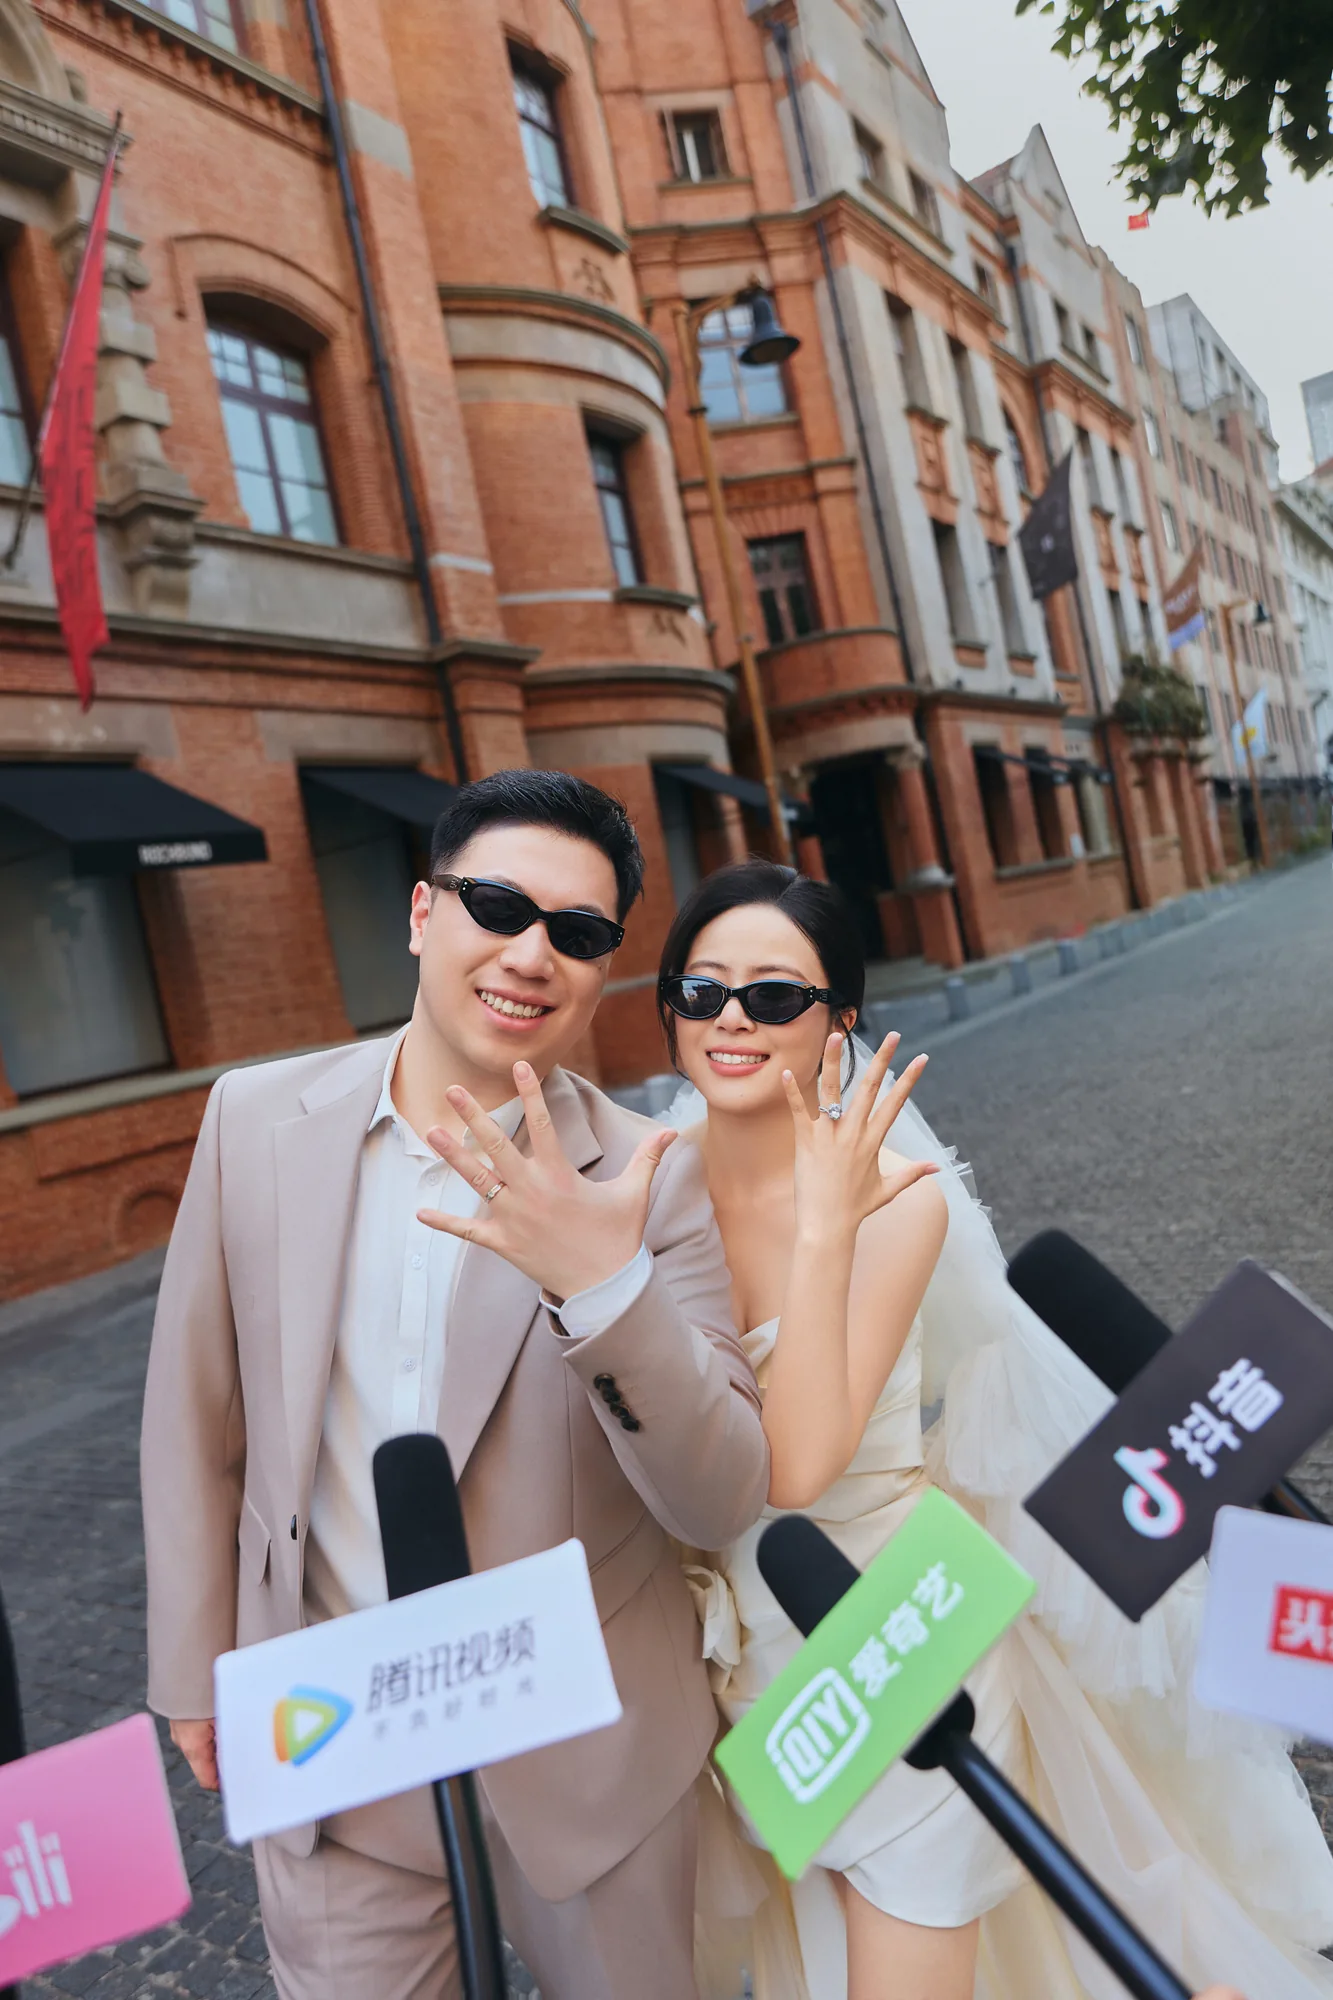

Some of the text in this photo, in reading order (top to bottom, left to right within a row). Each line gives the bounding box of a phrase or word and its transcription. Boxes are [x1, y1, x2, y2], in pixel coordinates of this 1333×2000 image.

[1168, 1357, 1284, 1479] 抖音
[365, 1615, 537, 1715] 腾讯视频
[848, 1560, 965, 1699] 爱奇艺
[1278, 1597, 1333, 1658] 头
